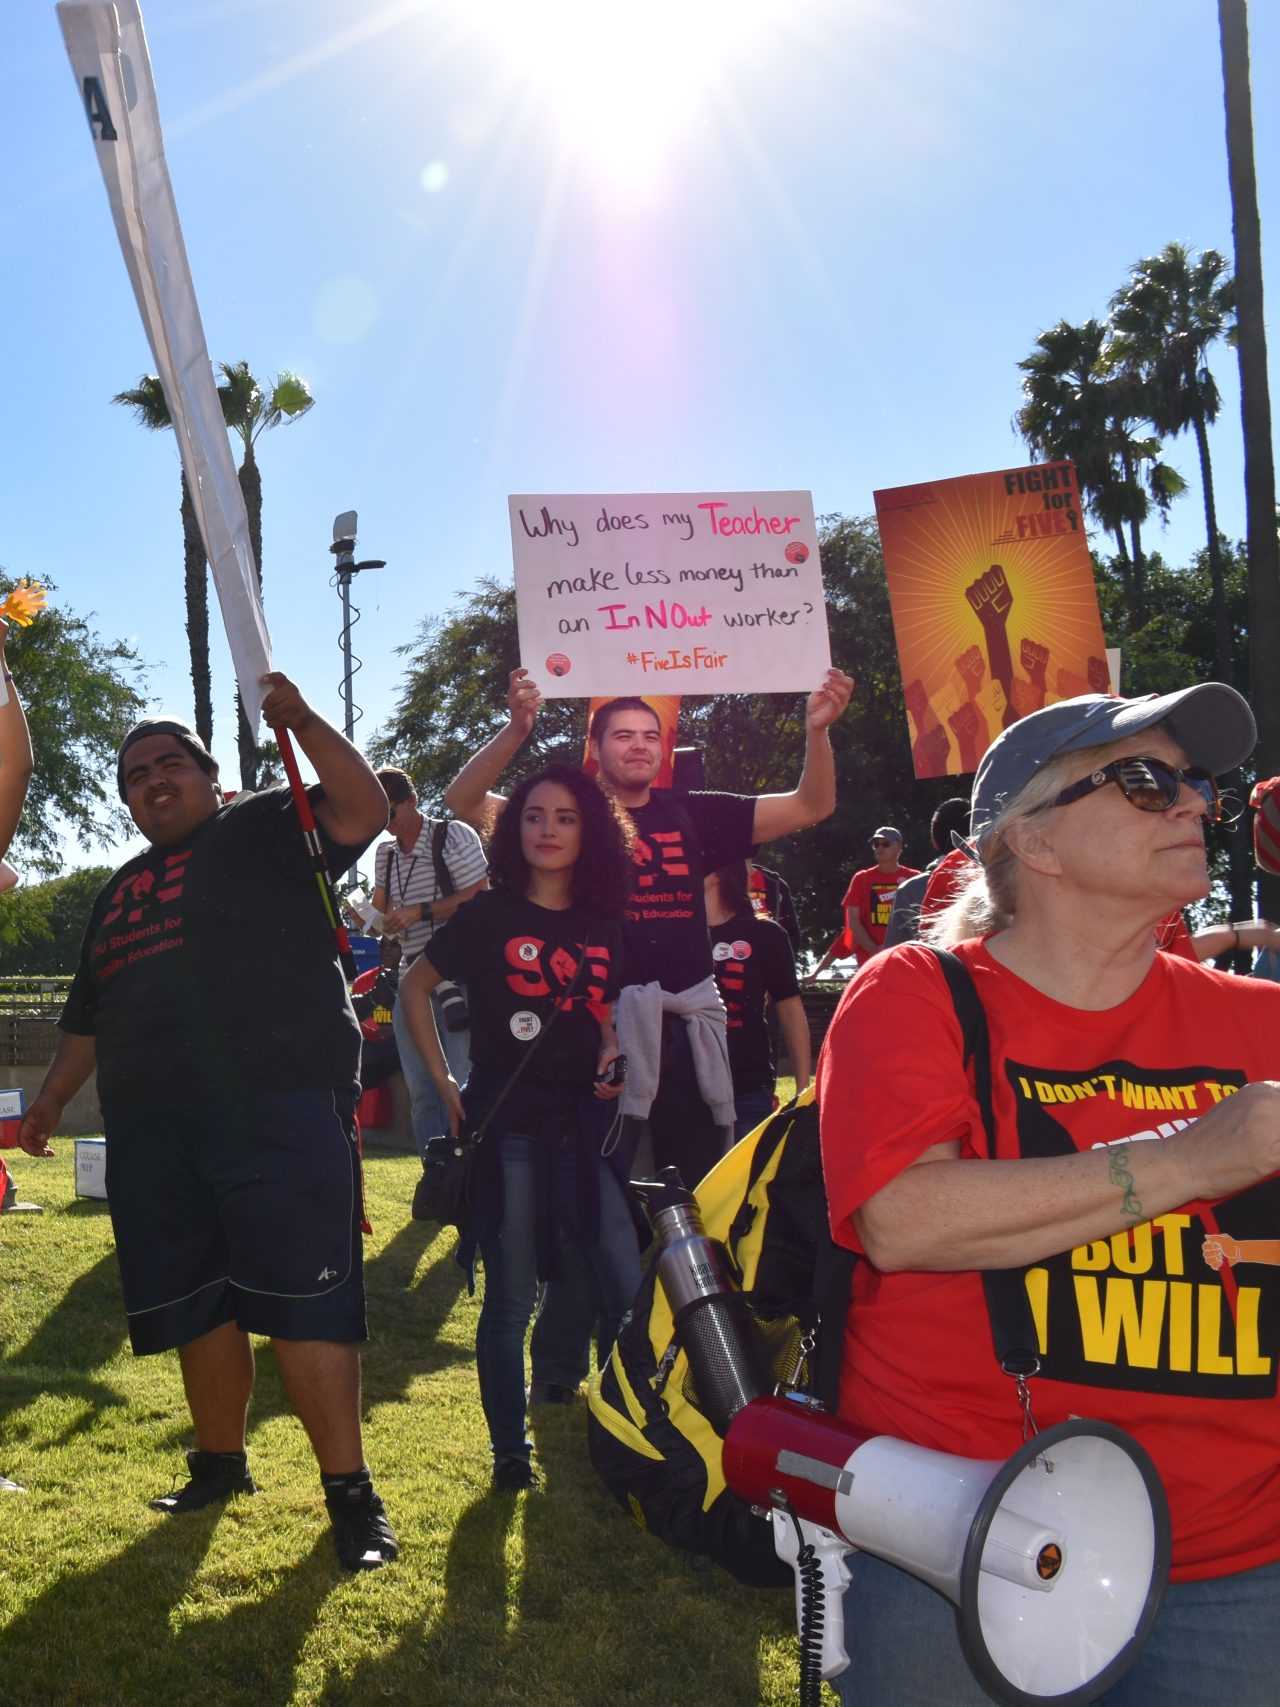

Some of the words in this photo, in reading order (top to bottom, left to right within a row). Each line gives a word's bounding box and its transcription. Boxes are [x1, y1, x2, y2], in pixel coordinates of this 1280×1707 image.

[1003, 465, 1070, 496] FIGHT
[1042, 492, 1073, 512] for
[519, 507, 580, 547] Why
[596, 508, 649, 533] does
[662, 510, 695, 541] my
[697, 501, 801, 537] Teacher
[547, 567, 619, 598] make
[625, 562, 671, 586] less
[679, 566, 744, 592] money
[752, 562, 799, 580] than
[558, 614, 590, 634] an
[723, 602, 814, 629] worker?
[1019, 1076, 1032, 1099] I
[1034, 1075, 1117, 1105] DON'T
[1121, 1077, 1198, 1110] WANT
[1071, 1213, 1191, 1276] BUT
[1024, 1267, 1049, 1356] I
[1073, 1275, 1271, 1376] WILL
